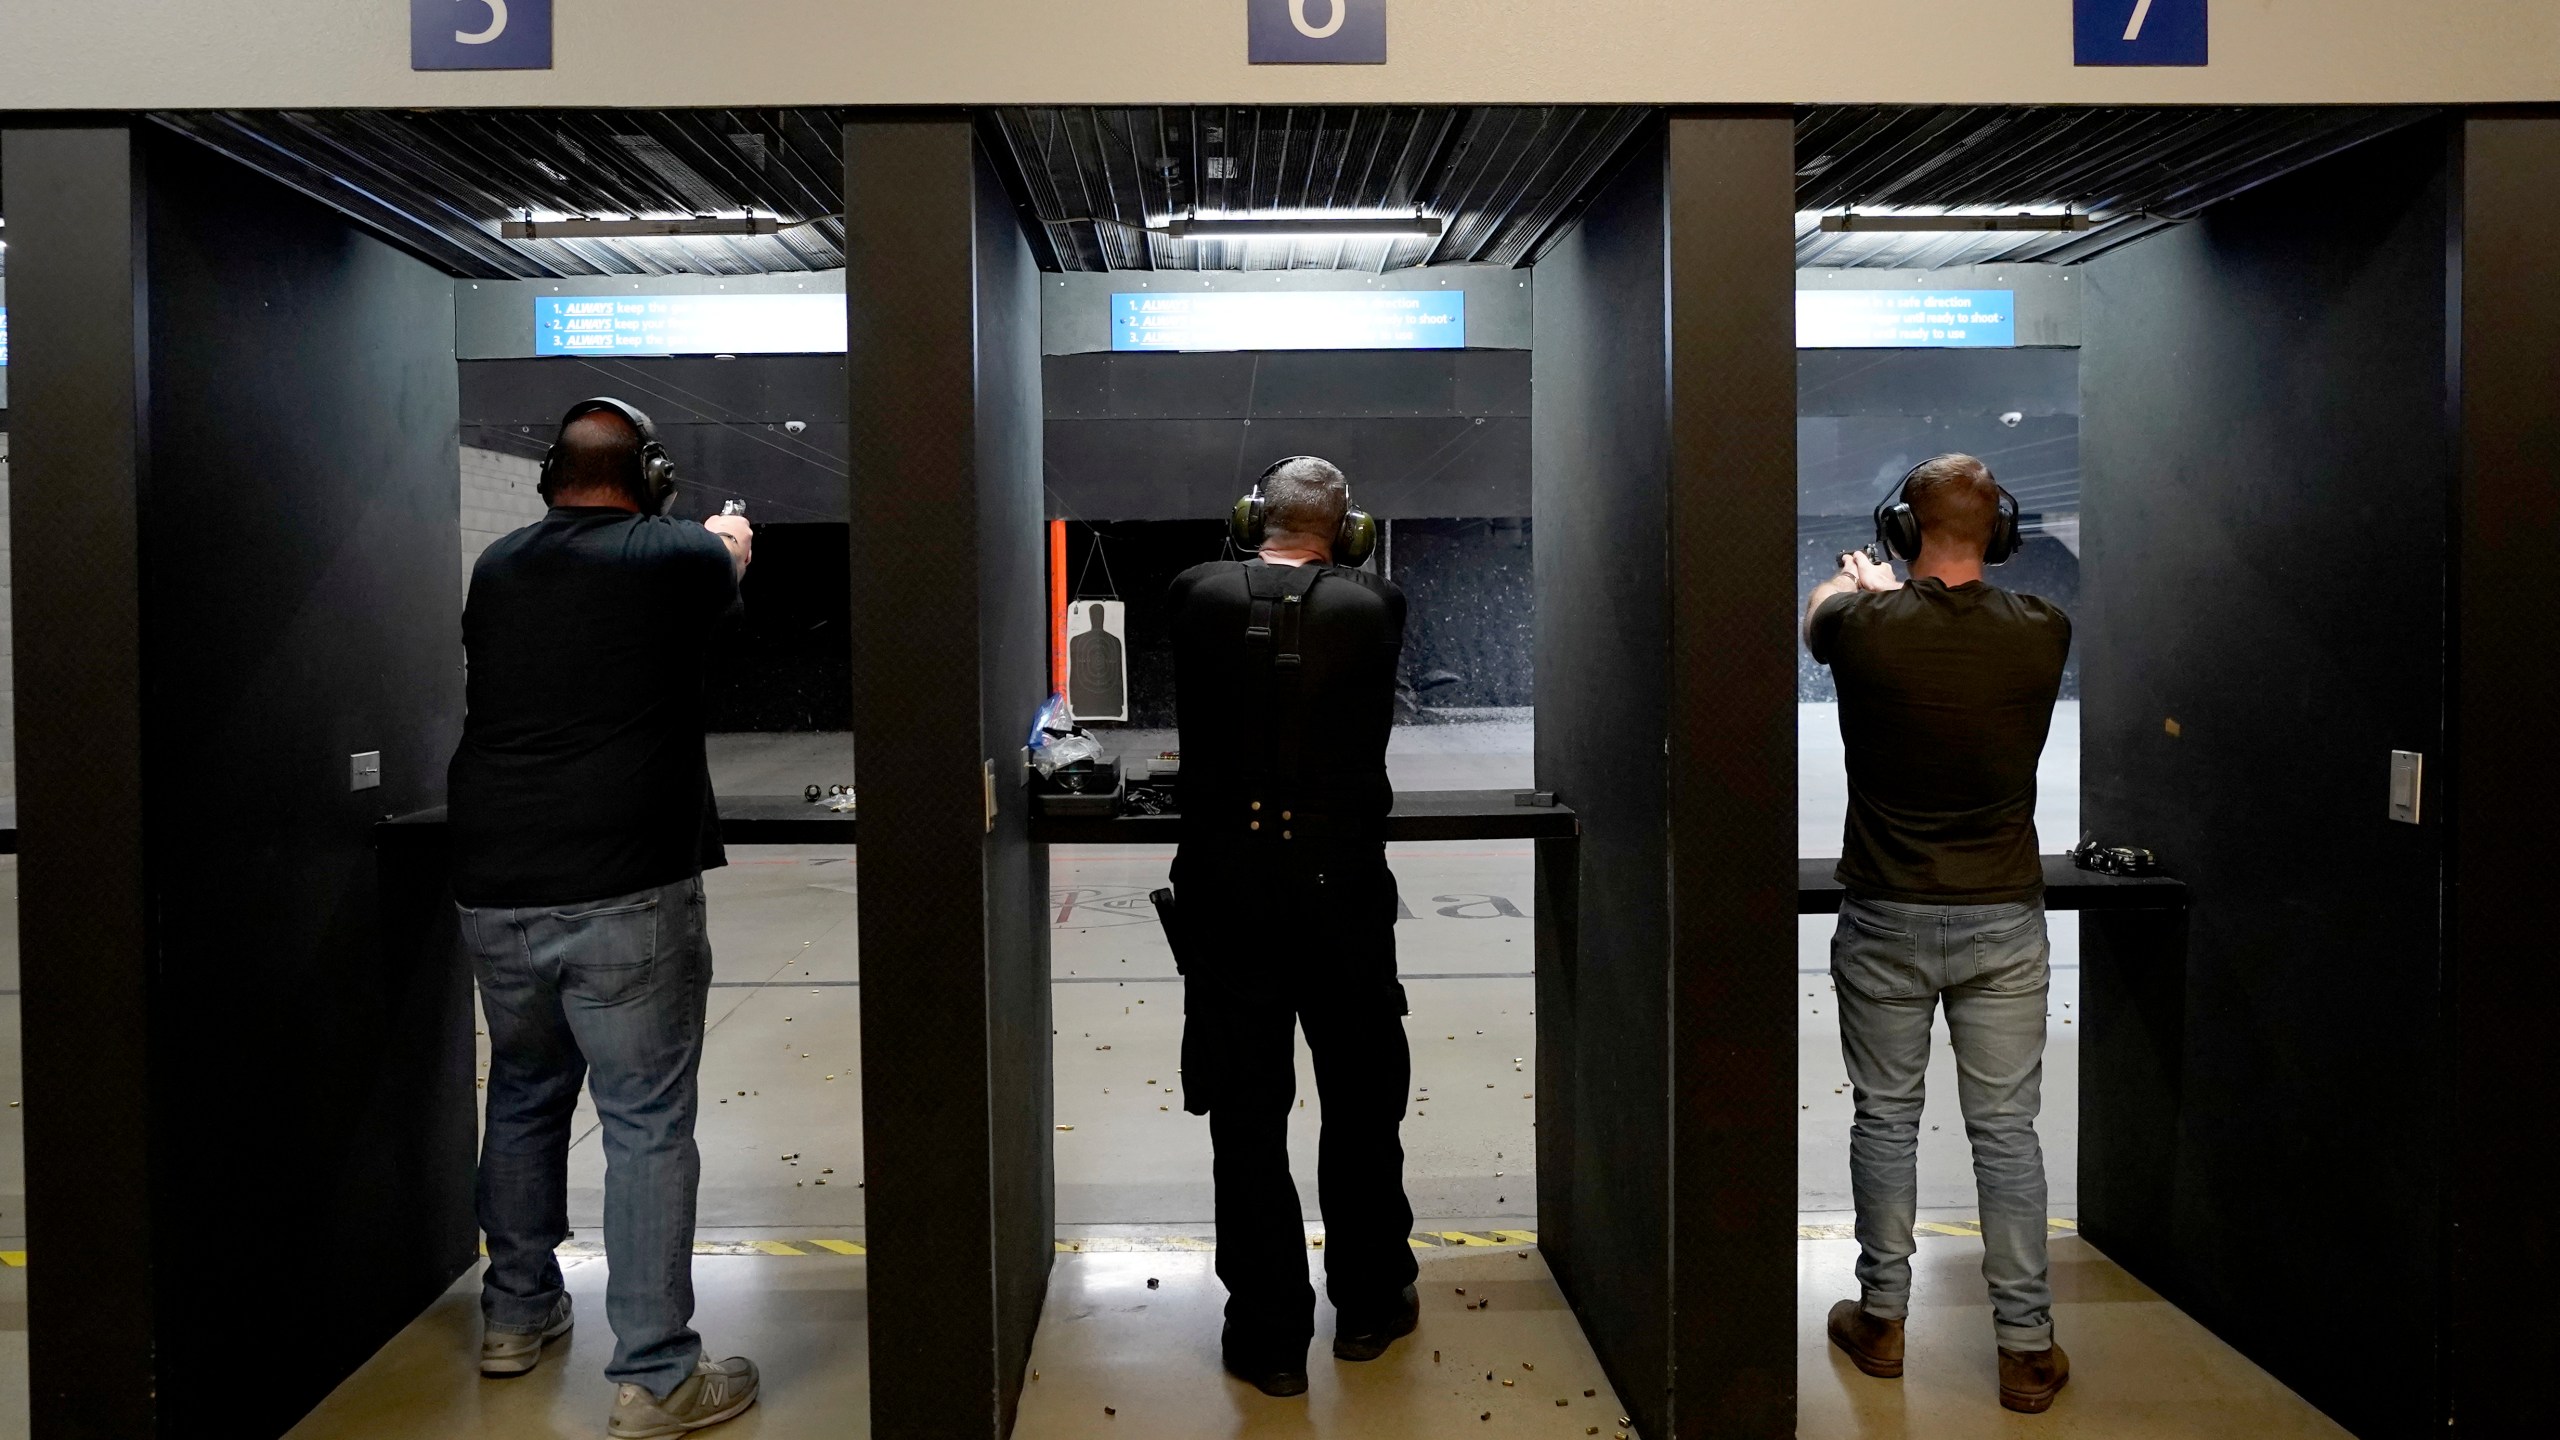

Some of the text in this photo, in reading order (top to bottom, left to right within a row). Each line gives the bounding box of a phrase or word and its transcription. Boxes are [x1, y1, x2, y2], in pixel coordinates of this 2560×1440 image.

[553, 303, 562, 314] 1.
[564, 303, 614, 316] ALWAYS
[616, 302, 644, 316] keep
[1129, 300, 1138, 311] 1.
[1923, 296, 1972, 308] direction
[553, 319, 563, 330] 2.
[564, 318, 614, 332] ALWAYS
[614, 318, 641, 331] keep
[1129, 316, 1139, 327] 2.
[1418, 313, 1448, 325] shoot
[1927, 312, 1956, 326] ready
[1957, 313, 1969, 324] to
[1970, 312, 1999, 324] shoot
[553, 335, 563, 347] 3.
[564, 335, 614, 348] ALWAYS
[615, 334, 643, 348] keep
[1129, 332, 1139, 343] 3.
[1899, 328, 1929, 342] ready
[1932, 329, 1945, 339] to
[1947, 330, 1966, 340] use
[702, 1382, 723, 1406] N
